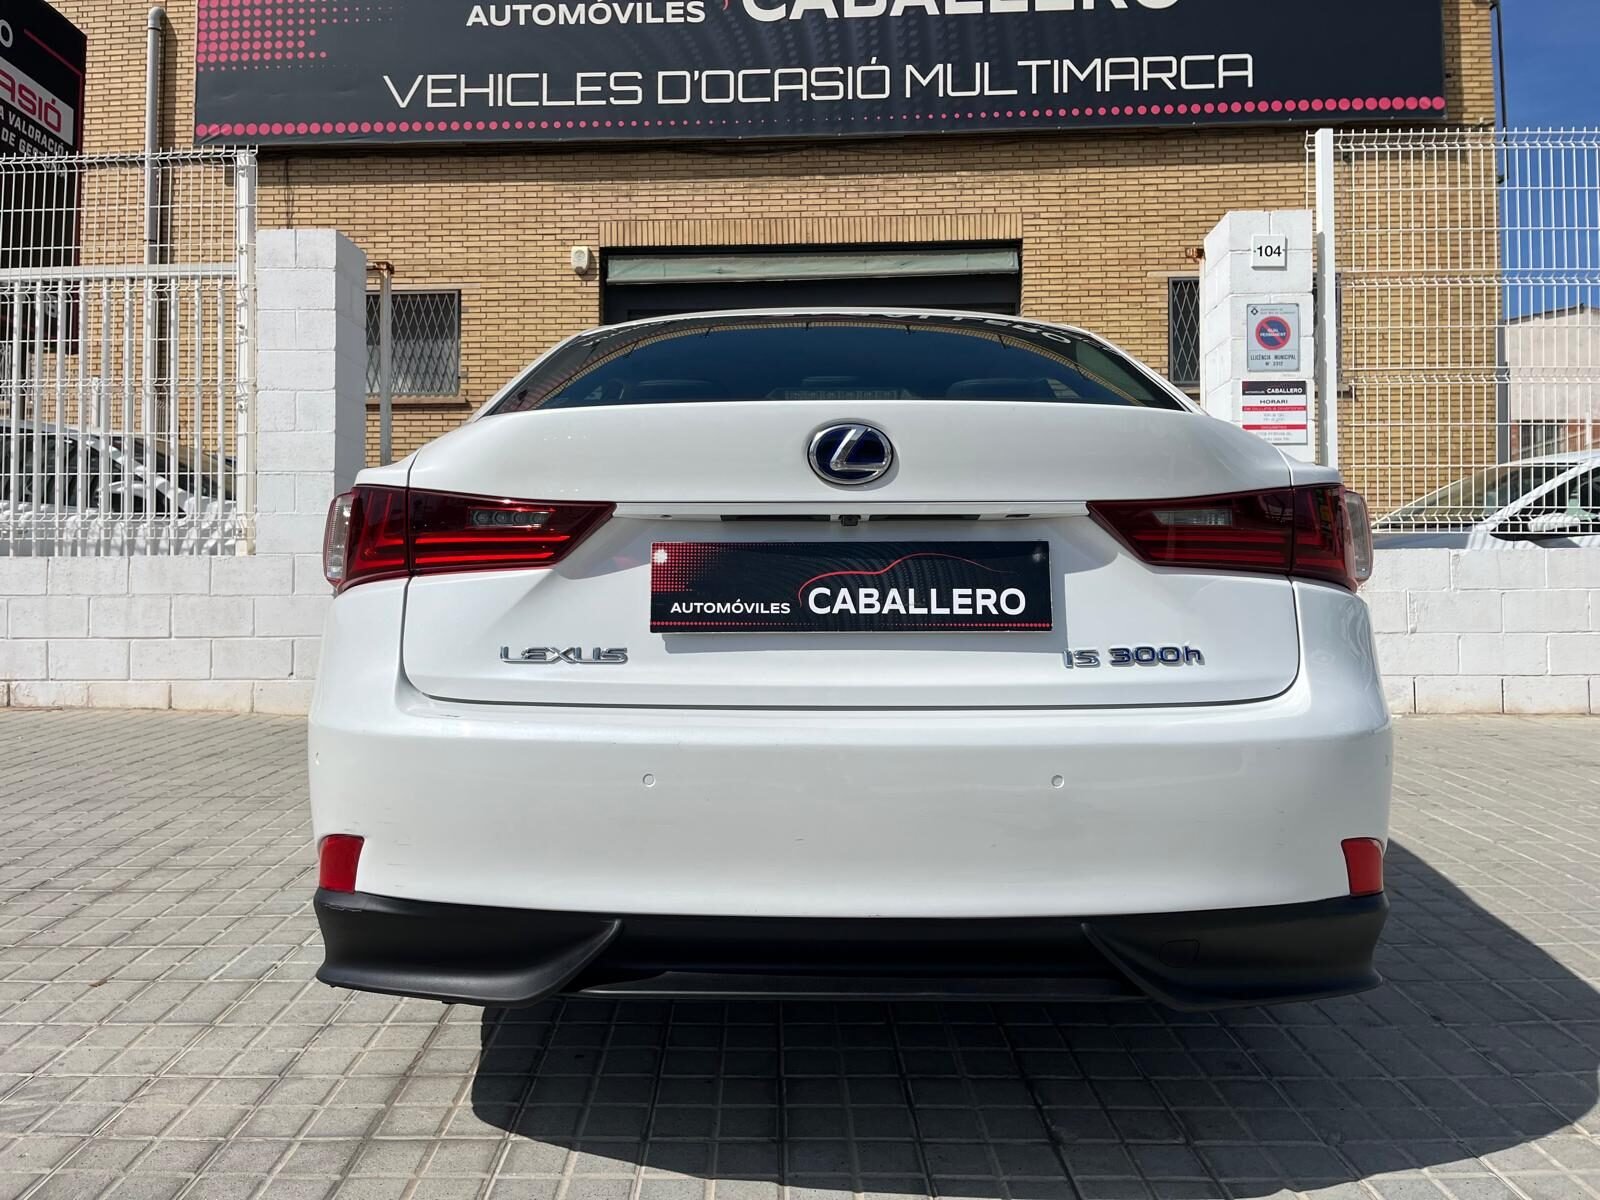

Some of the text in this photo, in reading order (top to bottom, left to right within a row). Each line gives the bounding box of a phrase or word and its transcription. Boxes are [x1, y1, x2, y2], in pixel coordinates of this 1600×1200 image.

[466, 0, 706, 27] AUTOMÓVILES
[383, 53, 1254, 108] VEHICLES D'OCASIÓ MULTIMARCA
[1, 127, 16, 147] DE
[1256, 245, 1282, 257] 104
[670, 587, 1026, 616] AUTOMÓVILES CABALLERO
[500, 646, 628, 664] LEXUS
[1063, 645, 1205, 669] IS 300h
